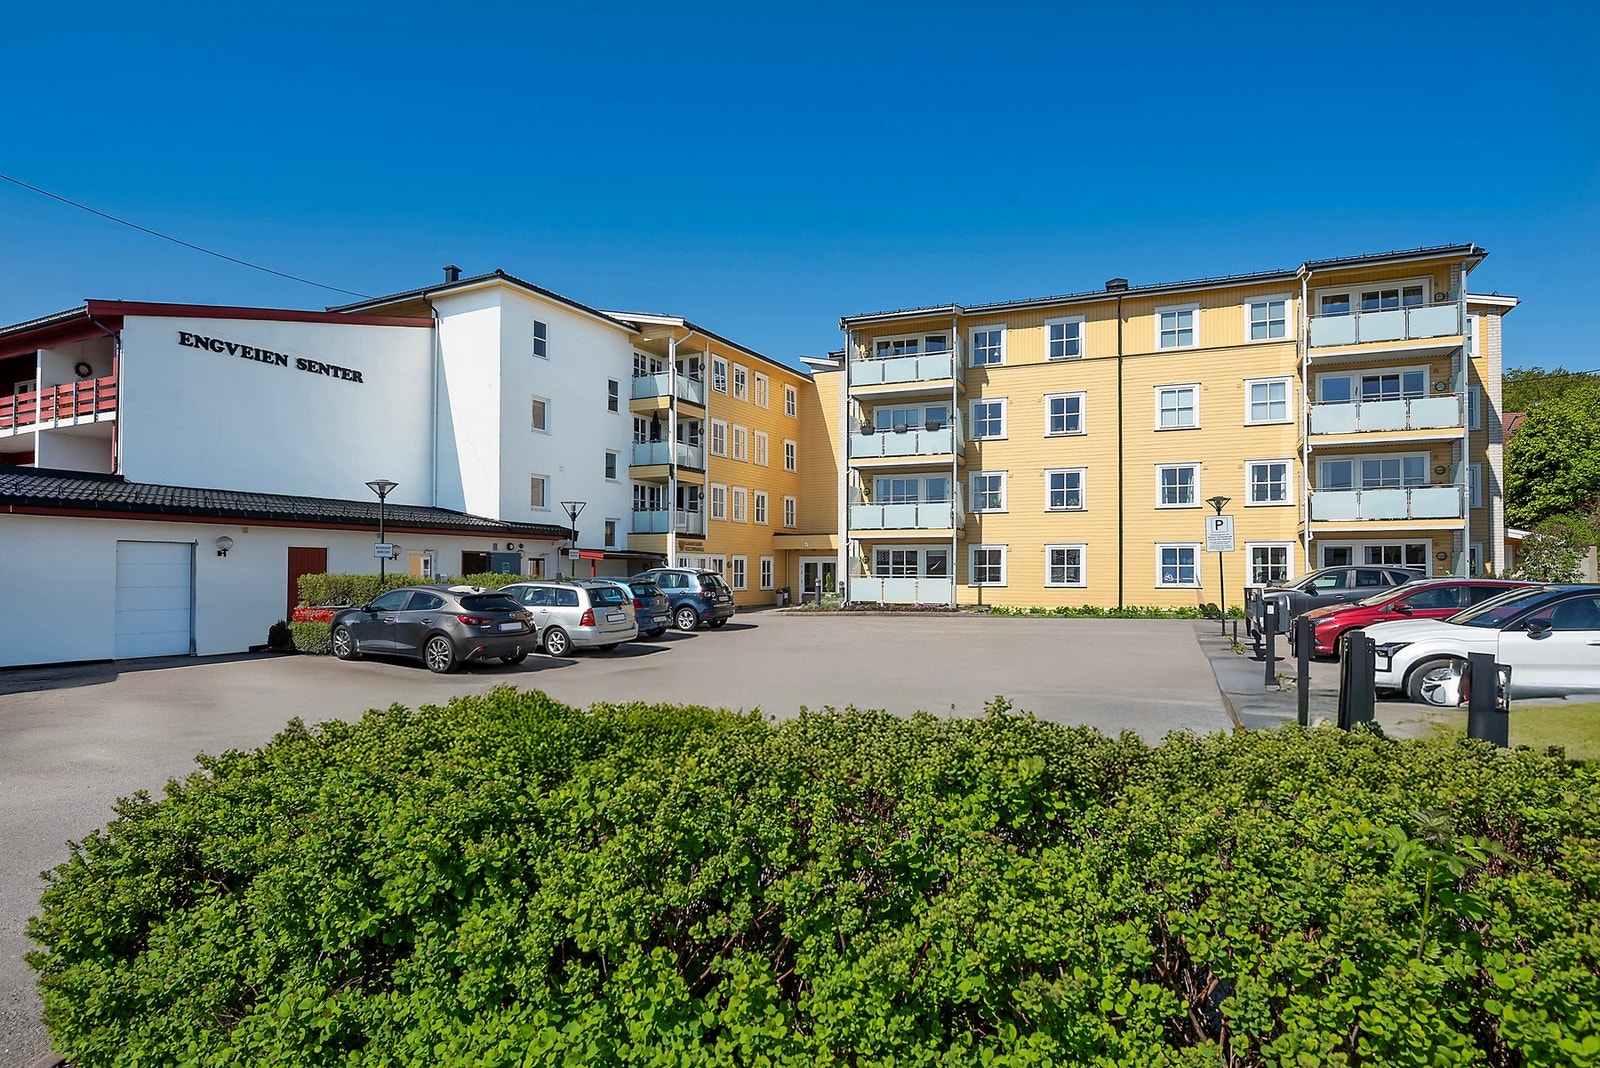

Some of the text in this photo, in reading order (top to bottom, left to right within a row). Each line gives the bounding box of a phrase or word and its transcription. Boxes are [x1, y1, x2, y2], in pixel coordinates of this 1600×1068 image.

[178, 331, 364, 383] ENGVEIEN SENTER
[1215, 519, 1224, 531] P
